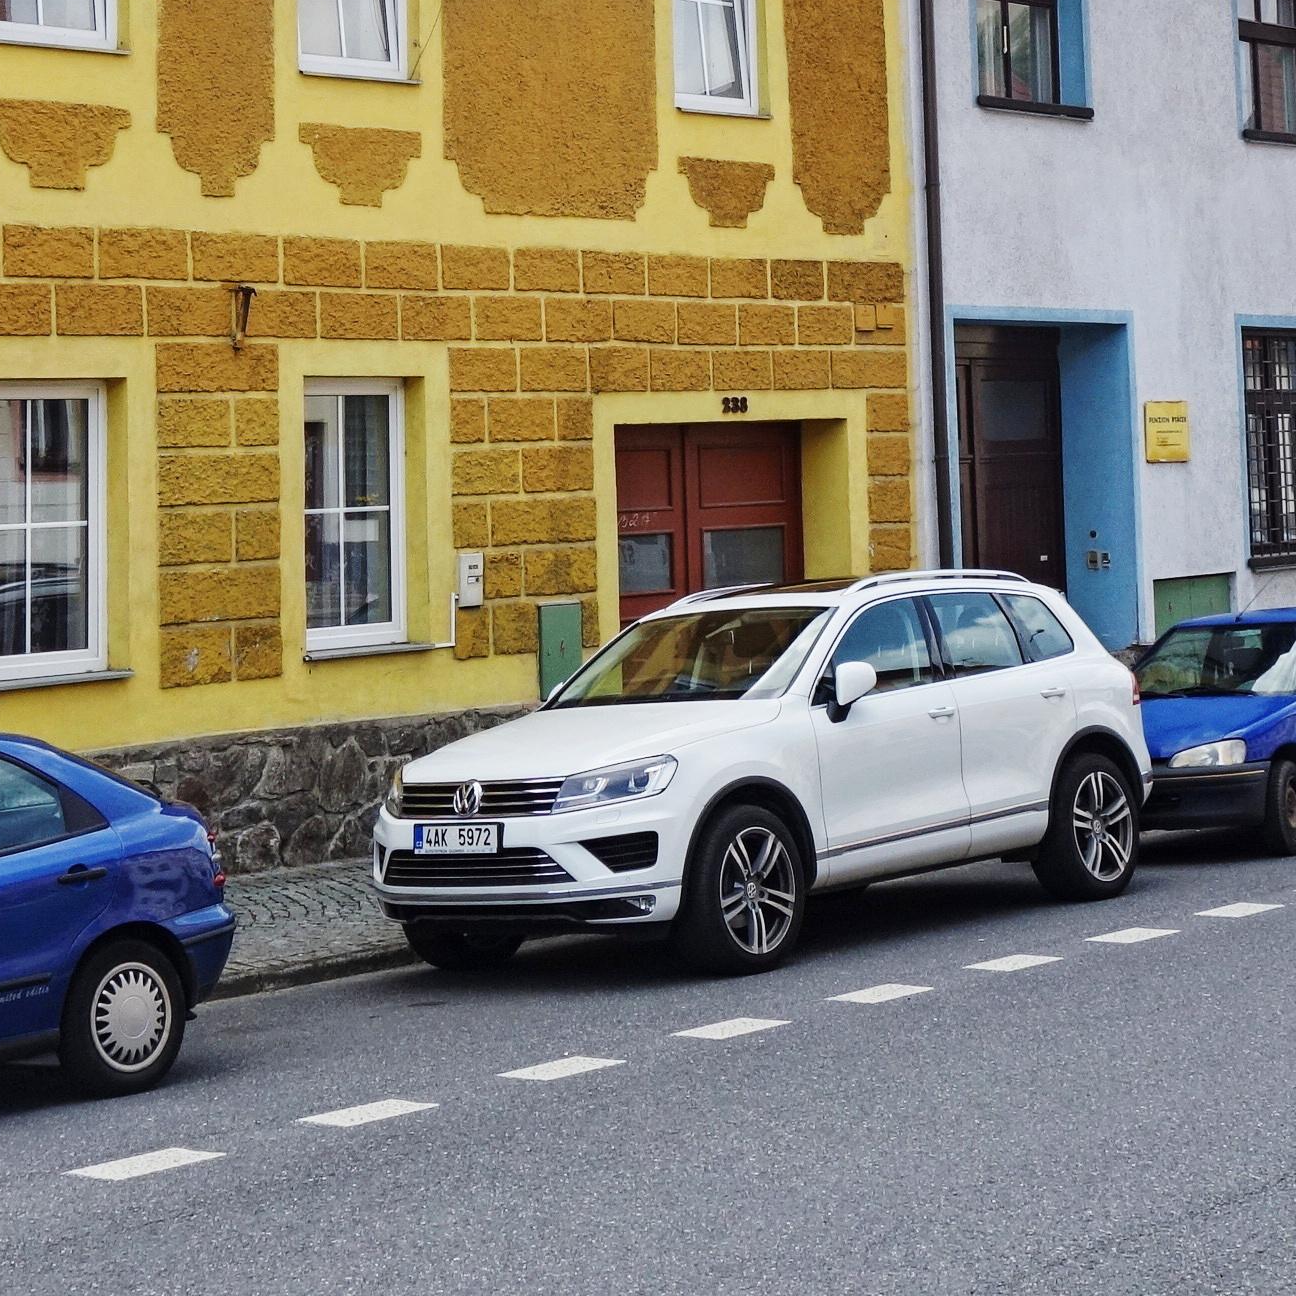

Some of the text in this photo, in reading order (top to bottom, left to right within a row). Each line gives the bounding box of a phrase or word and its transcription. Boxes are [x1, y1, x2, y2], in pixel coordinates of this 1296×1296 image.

[721, 396, 749, 414] 238
[425, 828, 448, 847] 4AK
[458, 827, 491, 846] 5972
